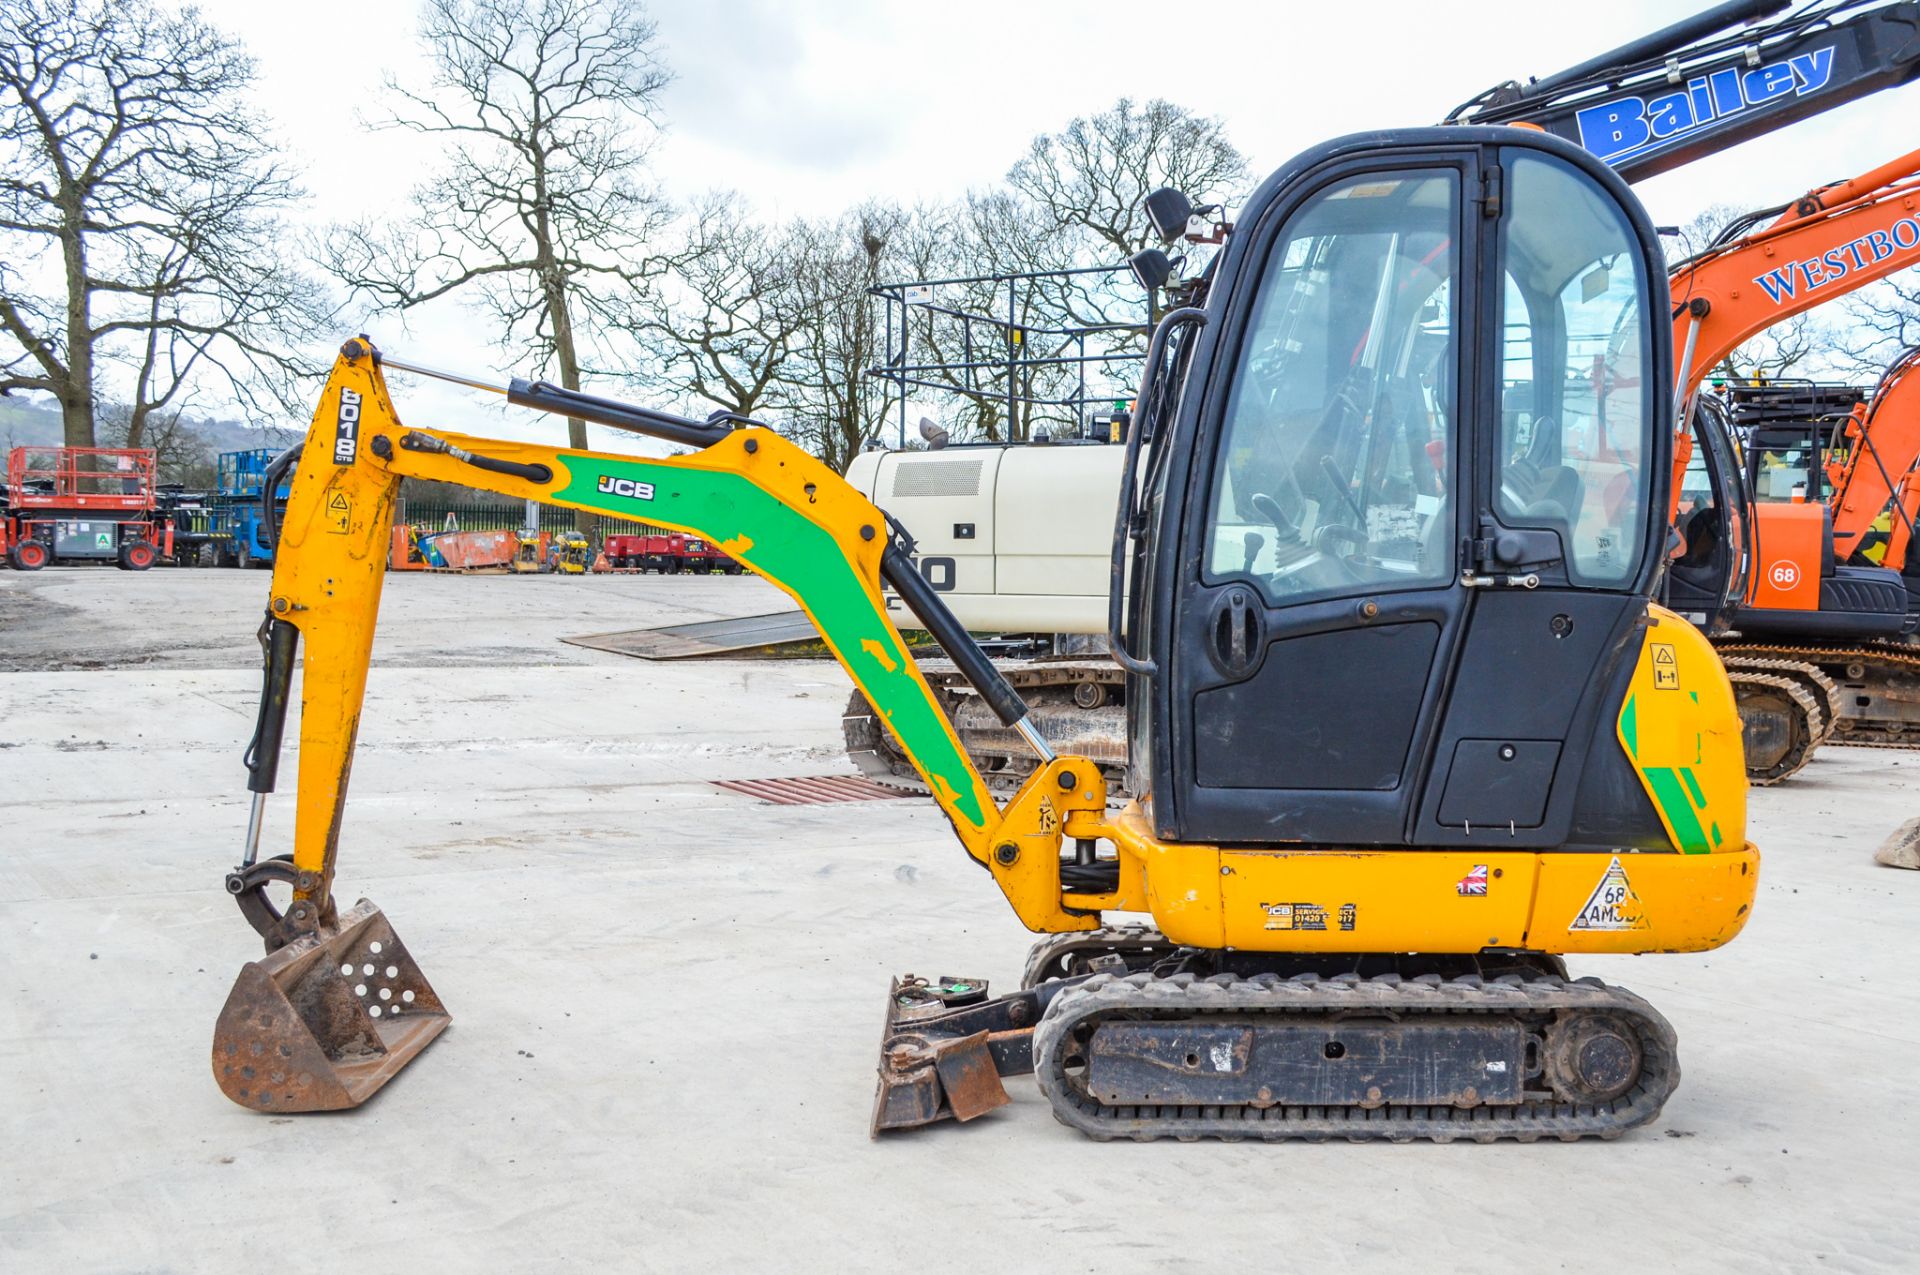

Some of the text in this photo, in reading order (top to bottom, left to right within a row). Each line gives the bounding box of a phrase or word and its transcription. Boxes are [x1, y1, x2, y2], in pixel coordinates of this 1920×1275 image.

[1576, 46, 1835, 160] Bailey
[1753, 212, 1920, 305] WESTBO
[336, 386, 361, 456] 8018
[598, 476, 655, 500] JCB
[1774, 567, 1795, 583] 68
